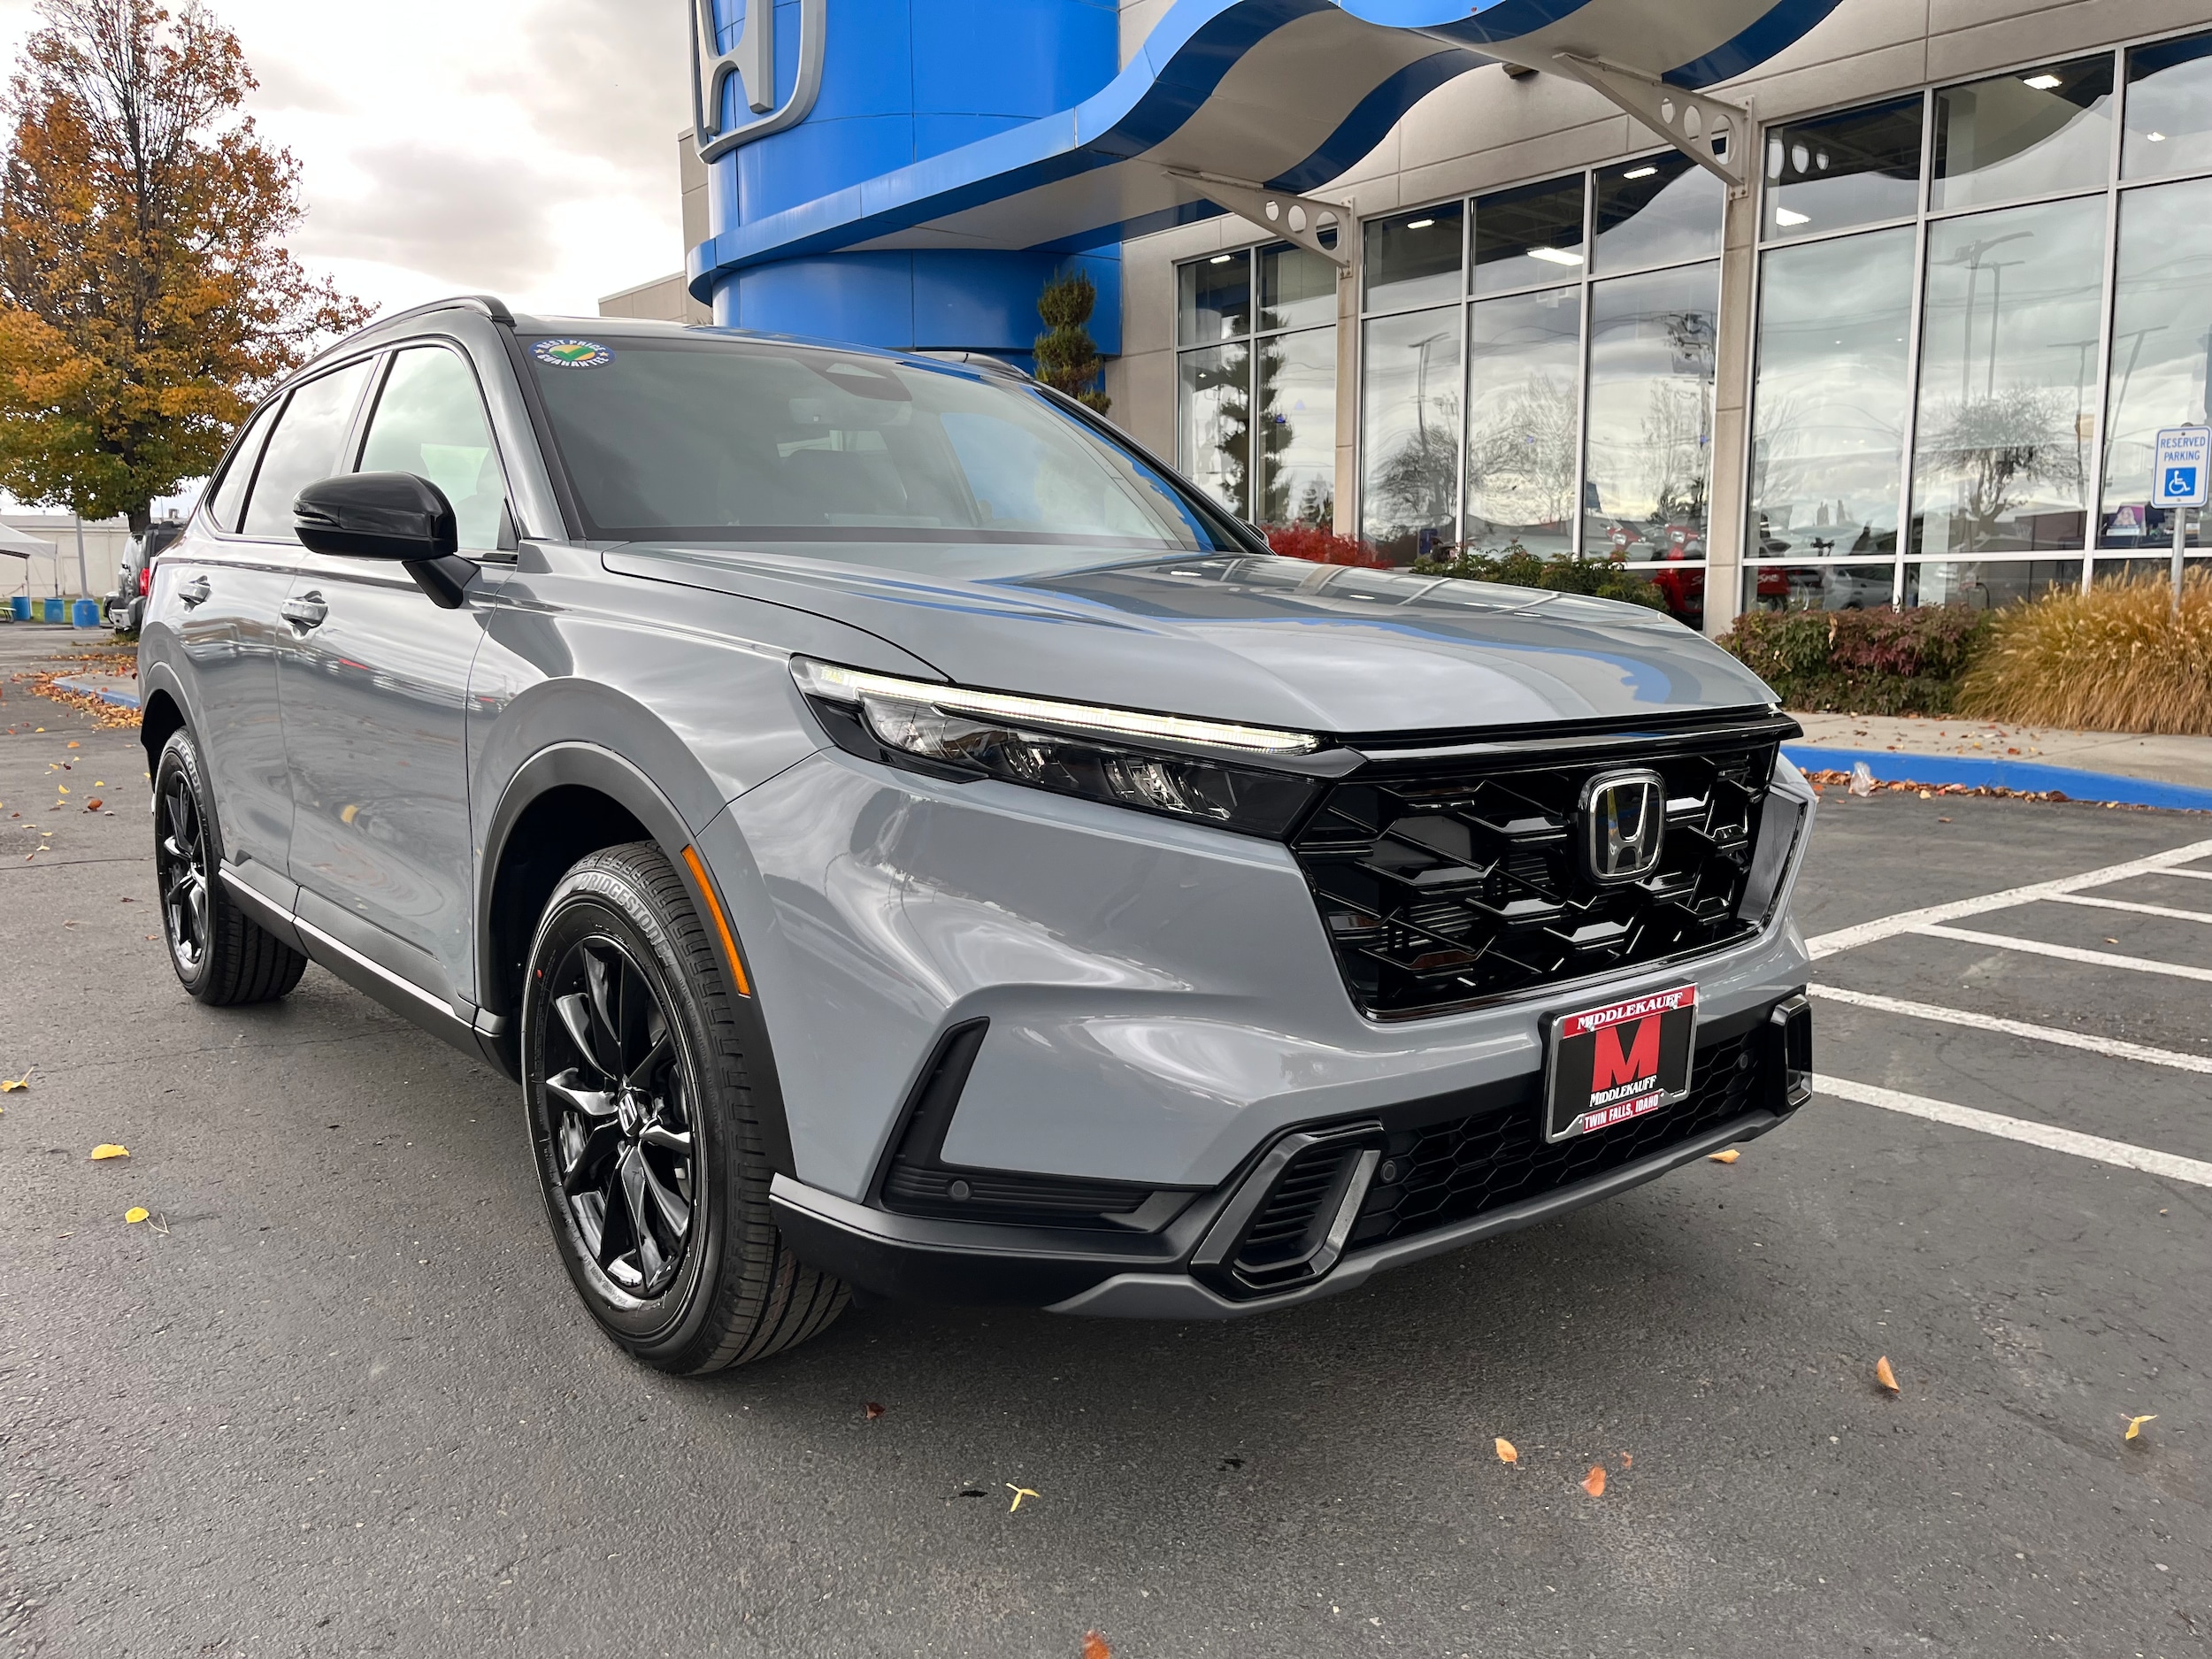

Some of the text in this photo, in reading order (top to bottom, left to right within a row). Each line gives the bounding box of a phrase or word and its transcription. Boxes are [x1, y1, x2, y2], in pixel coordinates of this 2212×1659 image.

[536, 339, 606, 351] BEST PRICE
[536, 354, 610, 367] GUARANTEE
[2161, 436, 2206, 449] RESERVED
[2164, 450, 2200, 462] PARKING
[1576, 992, 1683, 1030] MIDDLEKAUFF
[1591, 1014, 1661, 1093] M
[1589, 1075, 1657, 1107] MIDDLEKAUFF
[1585, 1094, 1659, 1129] TWIN FALLS, IDAHO
